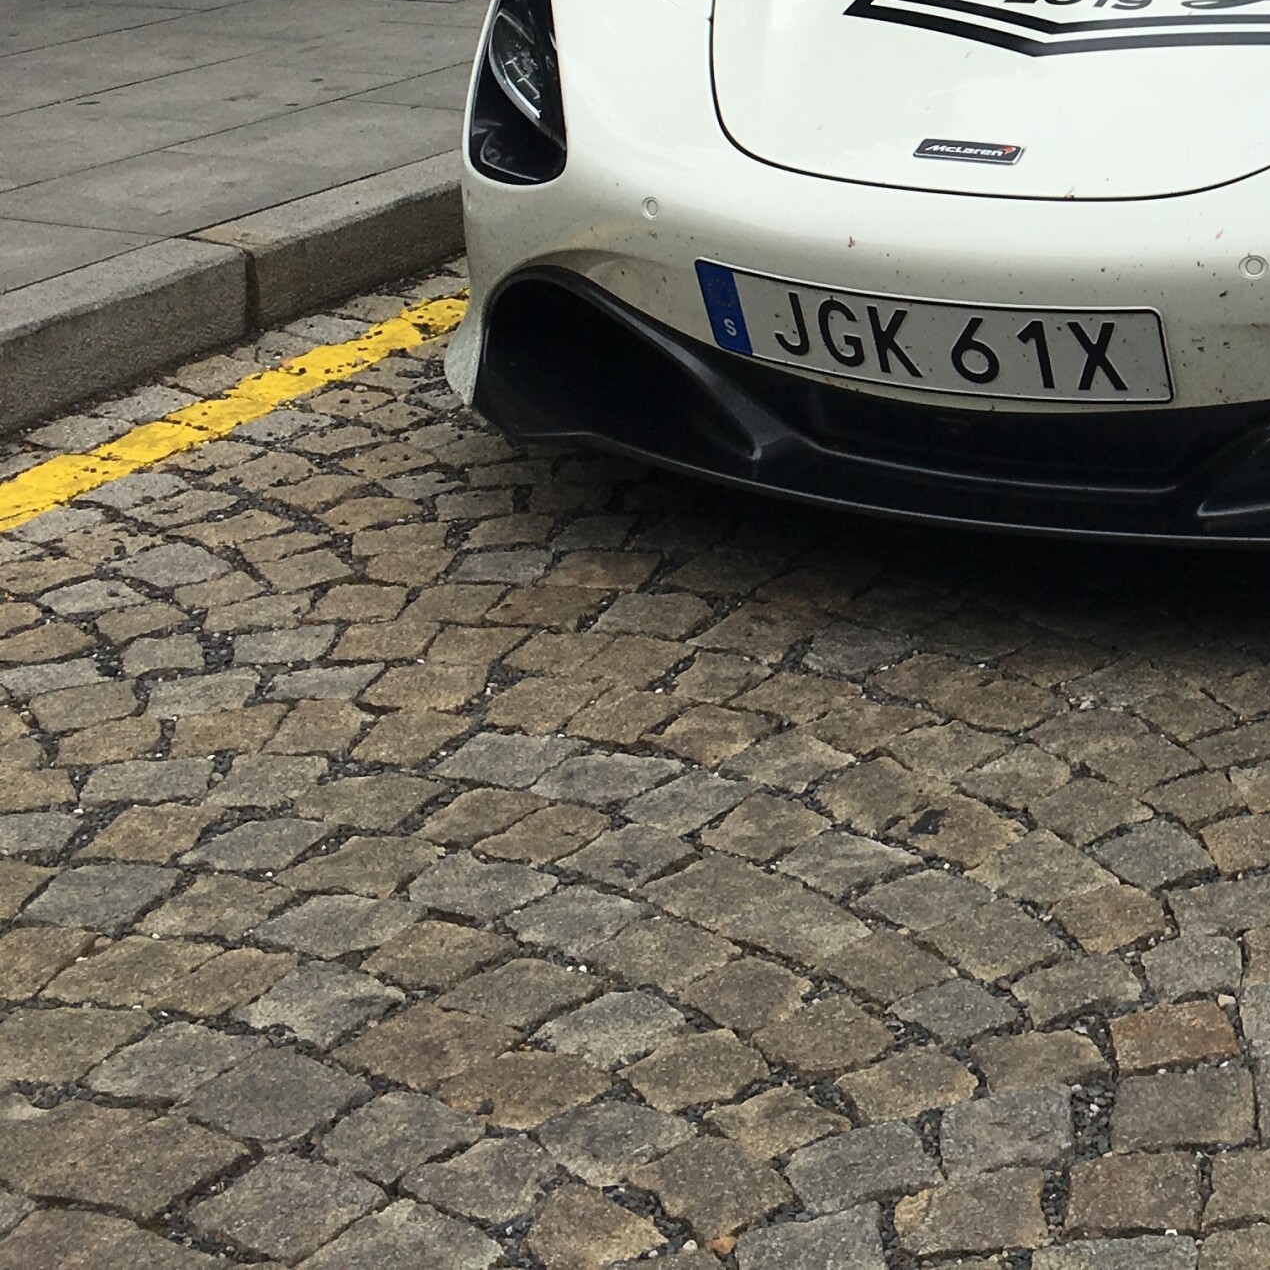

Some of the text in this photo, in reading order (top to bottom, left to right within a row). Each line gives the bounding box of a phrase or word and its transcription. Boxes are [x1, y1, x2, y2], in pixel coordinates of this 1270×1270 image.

[925, 145, 1003, 157] McLaren
[725, 317, 737, 337] S
[774, 292, 1129, 391] JGK 61X
